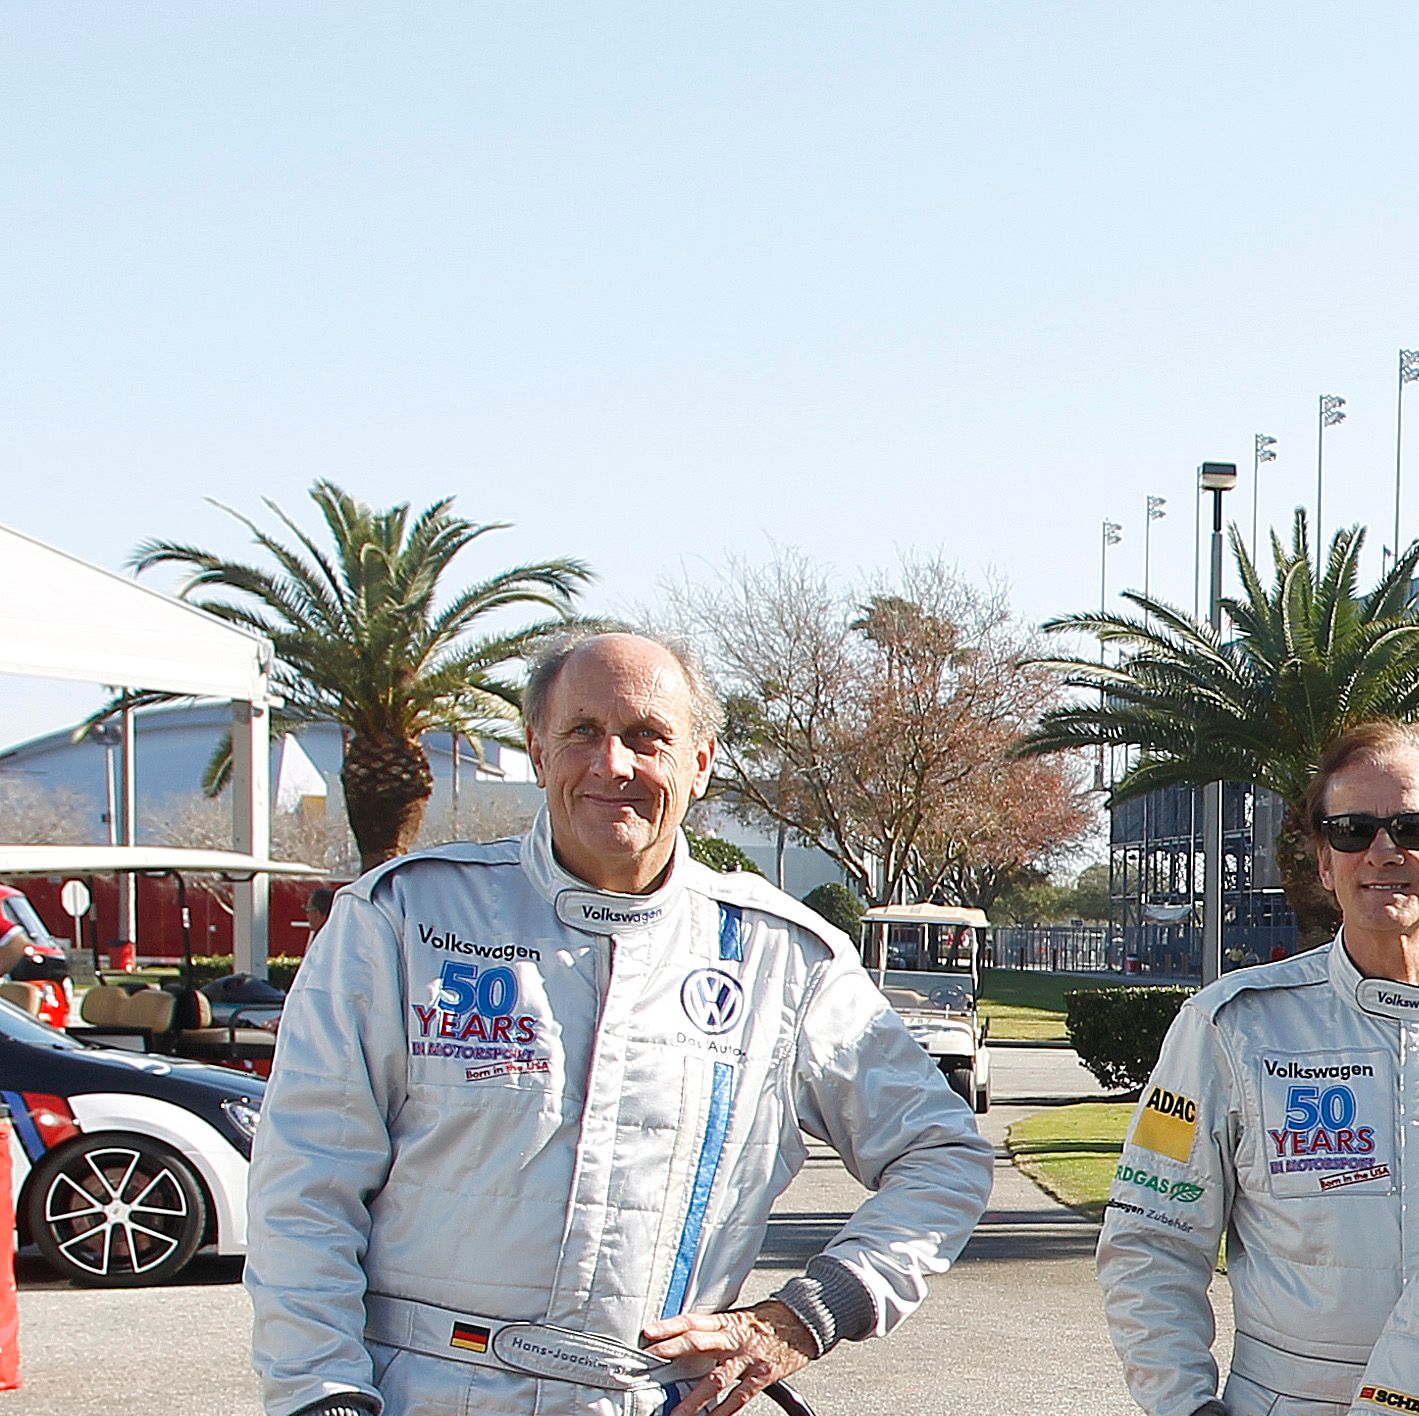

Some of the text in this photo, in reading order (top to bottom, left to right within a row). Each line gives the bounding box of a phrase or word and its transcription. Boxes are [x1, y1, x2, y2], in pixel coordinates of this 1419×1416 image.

[582, 905, 662, 924] Volkswagen
[418, 924, 541, 962] Volkswagen
[438, 960, 519, 1019] 50
[412, 1004, 538, 1045] YEARS
[429, 1042, 535, 1061] MOTORSPORT
[677, 1032, 702, 1048] Das
[466, 1068, 491, 1081] Born
[493, 1065, 504, 1075] in
[526, 1061, 550, 1073] USA
[1264, 1059, 1374, 1081] Volkswagen
[1146, 1087, 1197, 1123] ADAC
[1286, 1085, 1357, 1132] 50
[1268, 1127, 1376, 1157] YEARS
[1114, 1165, 1170, 1194] RDGAS
[1285, 1157, 1377, 1173] MOTORSPORT
[1370, 1167, 1391, 1178] USA
[511, 1336, 609, 1372] Hans-Joachim
